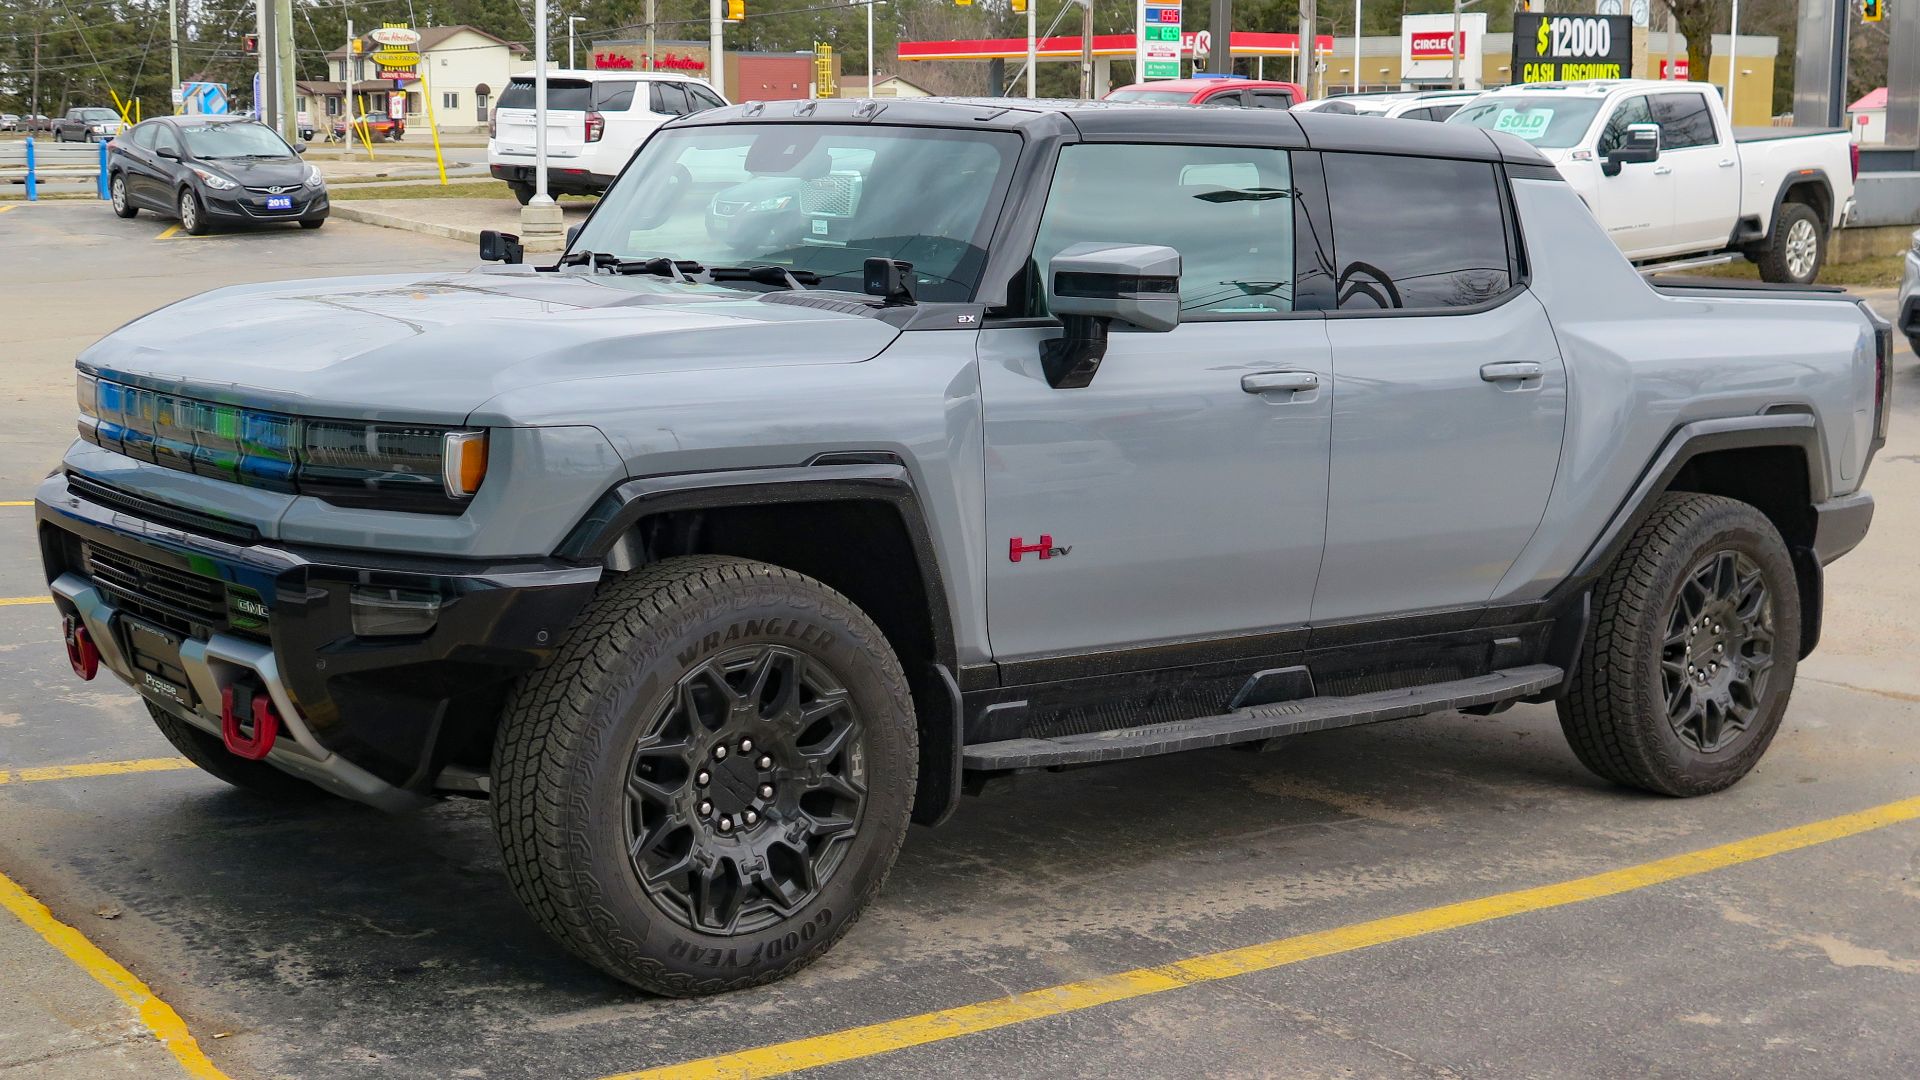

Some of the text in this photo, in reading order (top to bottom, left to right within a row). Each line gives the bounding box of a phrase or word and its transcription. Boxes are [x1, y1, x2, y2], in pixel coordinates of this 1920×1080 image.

[1200, 35, 1210, 53] K
[1413, 39, 1447, 49] CIRCLE
[1537, 17, 1610, 57] $12000
[1523, 63, 1620, 83] CASH DISCOUNTS
[1500, 115, 1545, 128] SOLD
[268, 198, 290, 207] 2015
[957, 315, 975, 323] 2X
[238, 599, 269, 617] GMC
[676, 618, 837, 669] WRANGLER
[145, 672, 177, 696] Prouse
